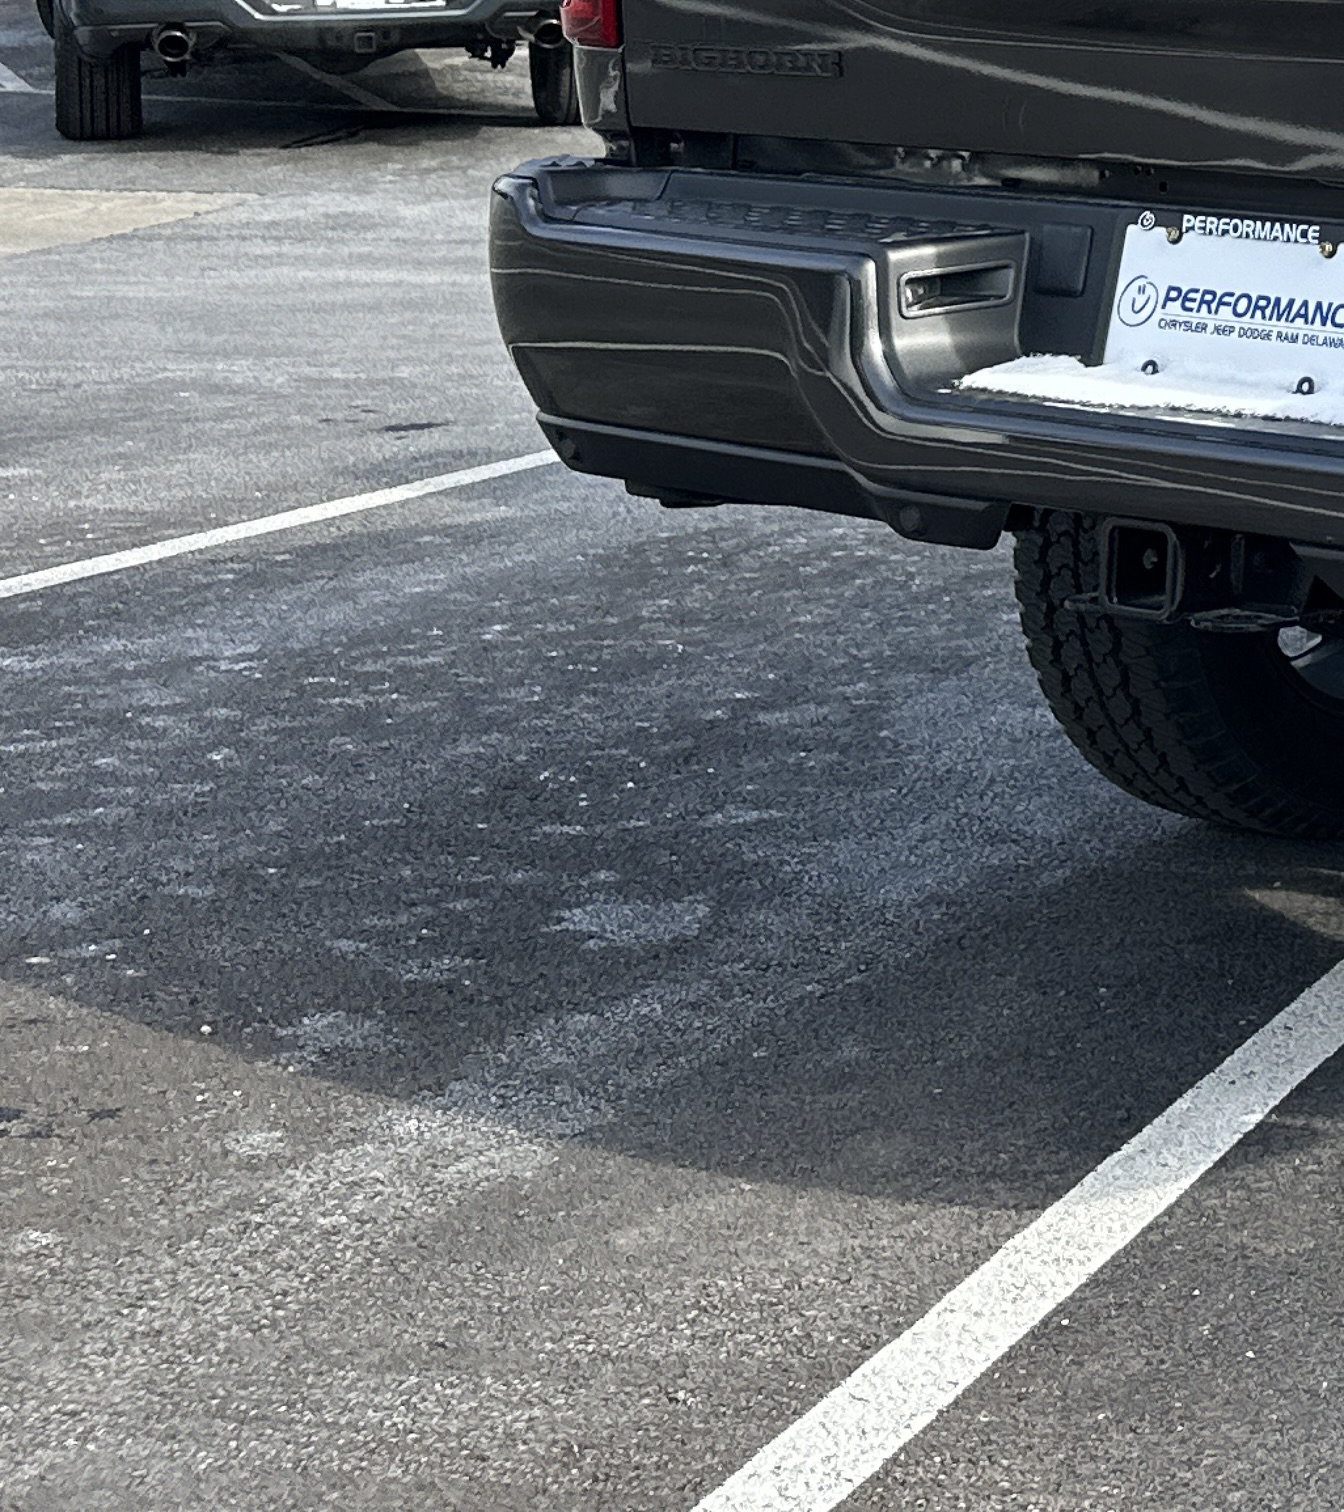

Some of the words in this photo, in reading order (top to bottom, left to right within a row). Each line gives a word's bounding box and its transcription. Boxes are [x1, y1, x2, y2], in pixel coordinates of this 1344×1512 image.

[1182, 214, 1320, 245] PERFORMANCE
[1158, 318, 1208, 335] CHRYSLER
[1210, 323, 1236, 337] JEEP
[1238, 327, 1273, 342] DODGE
[1275, 330, 1299, 345] RAM
